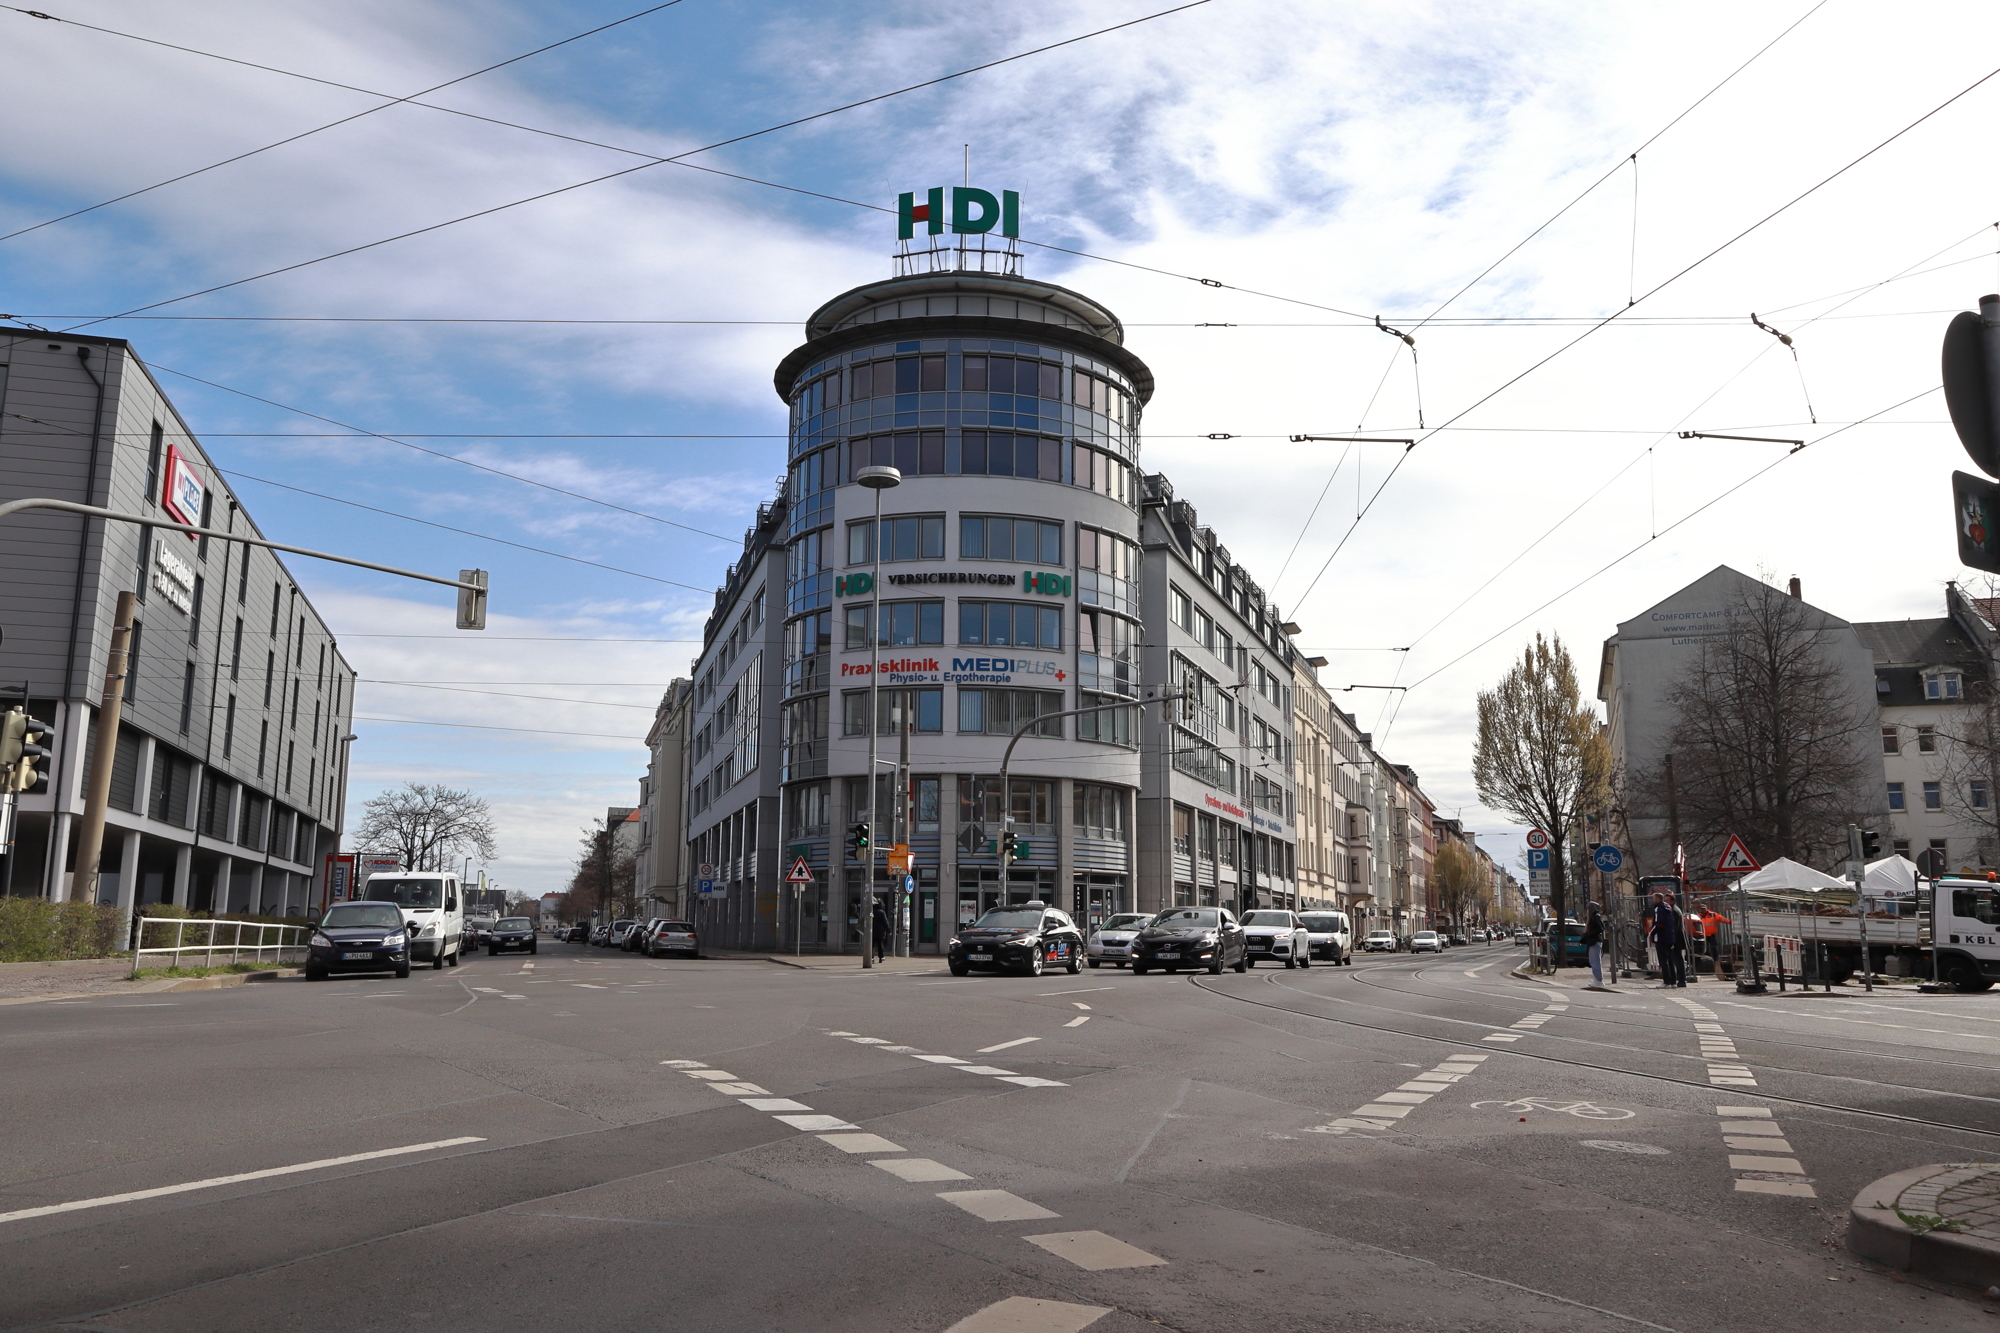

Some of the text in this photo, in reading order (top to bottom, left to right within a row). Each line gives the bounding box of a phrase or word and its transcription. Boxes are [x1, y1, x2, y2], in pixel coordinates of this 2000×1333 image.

[898, 186, 1020, 241] HDI
[888, 571, 1072, 597] VERSICHERUNGEN HDI
[841, 657, 1057, 677] Praxisklinik MEDIPLUS
[889, 672, 1012, 685] Physio- u. Ergotherapie
[1530, 834, 1544, 844] 30
[1532, 851, 1545, 868] P
[701, 880, 710, 892] P
